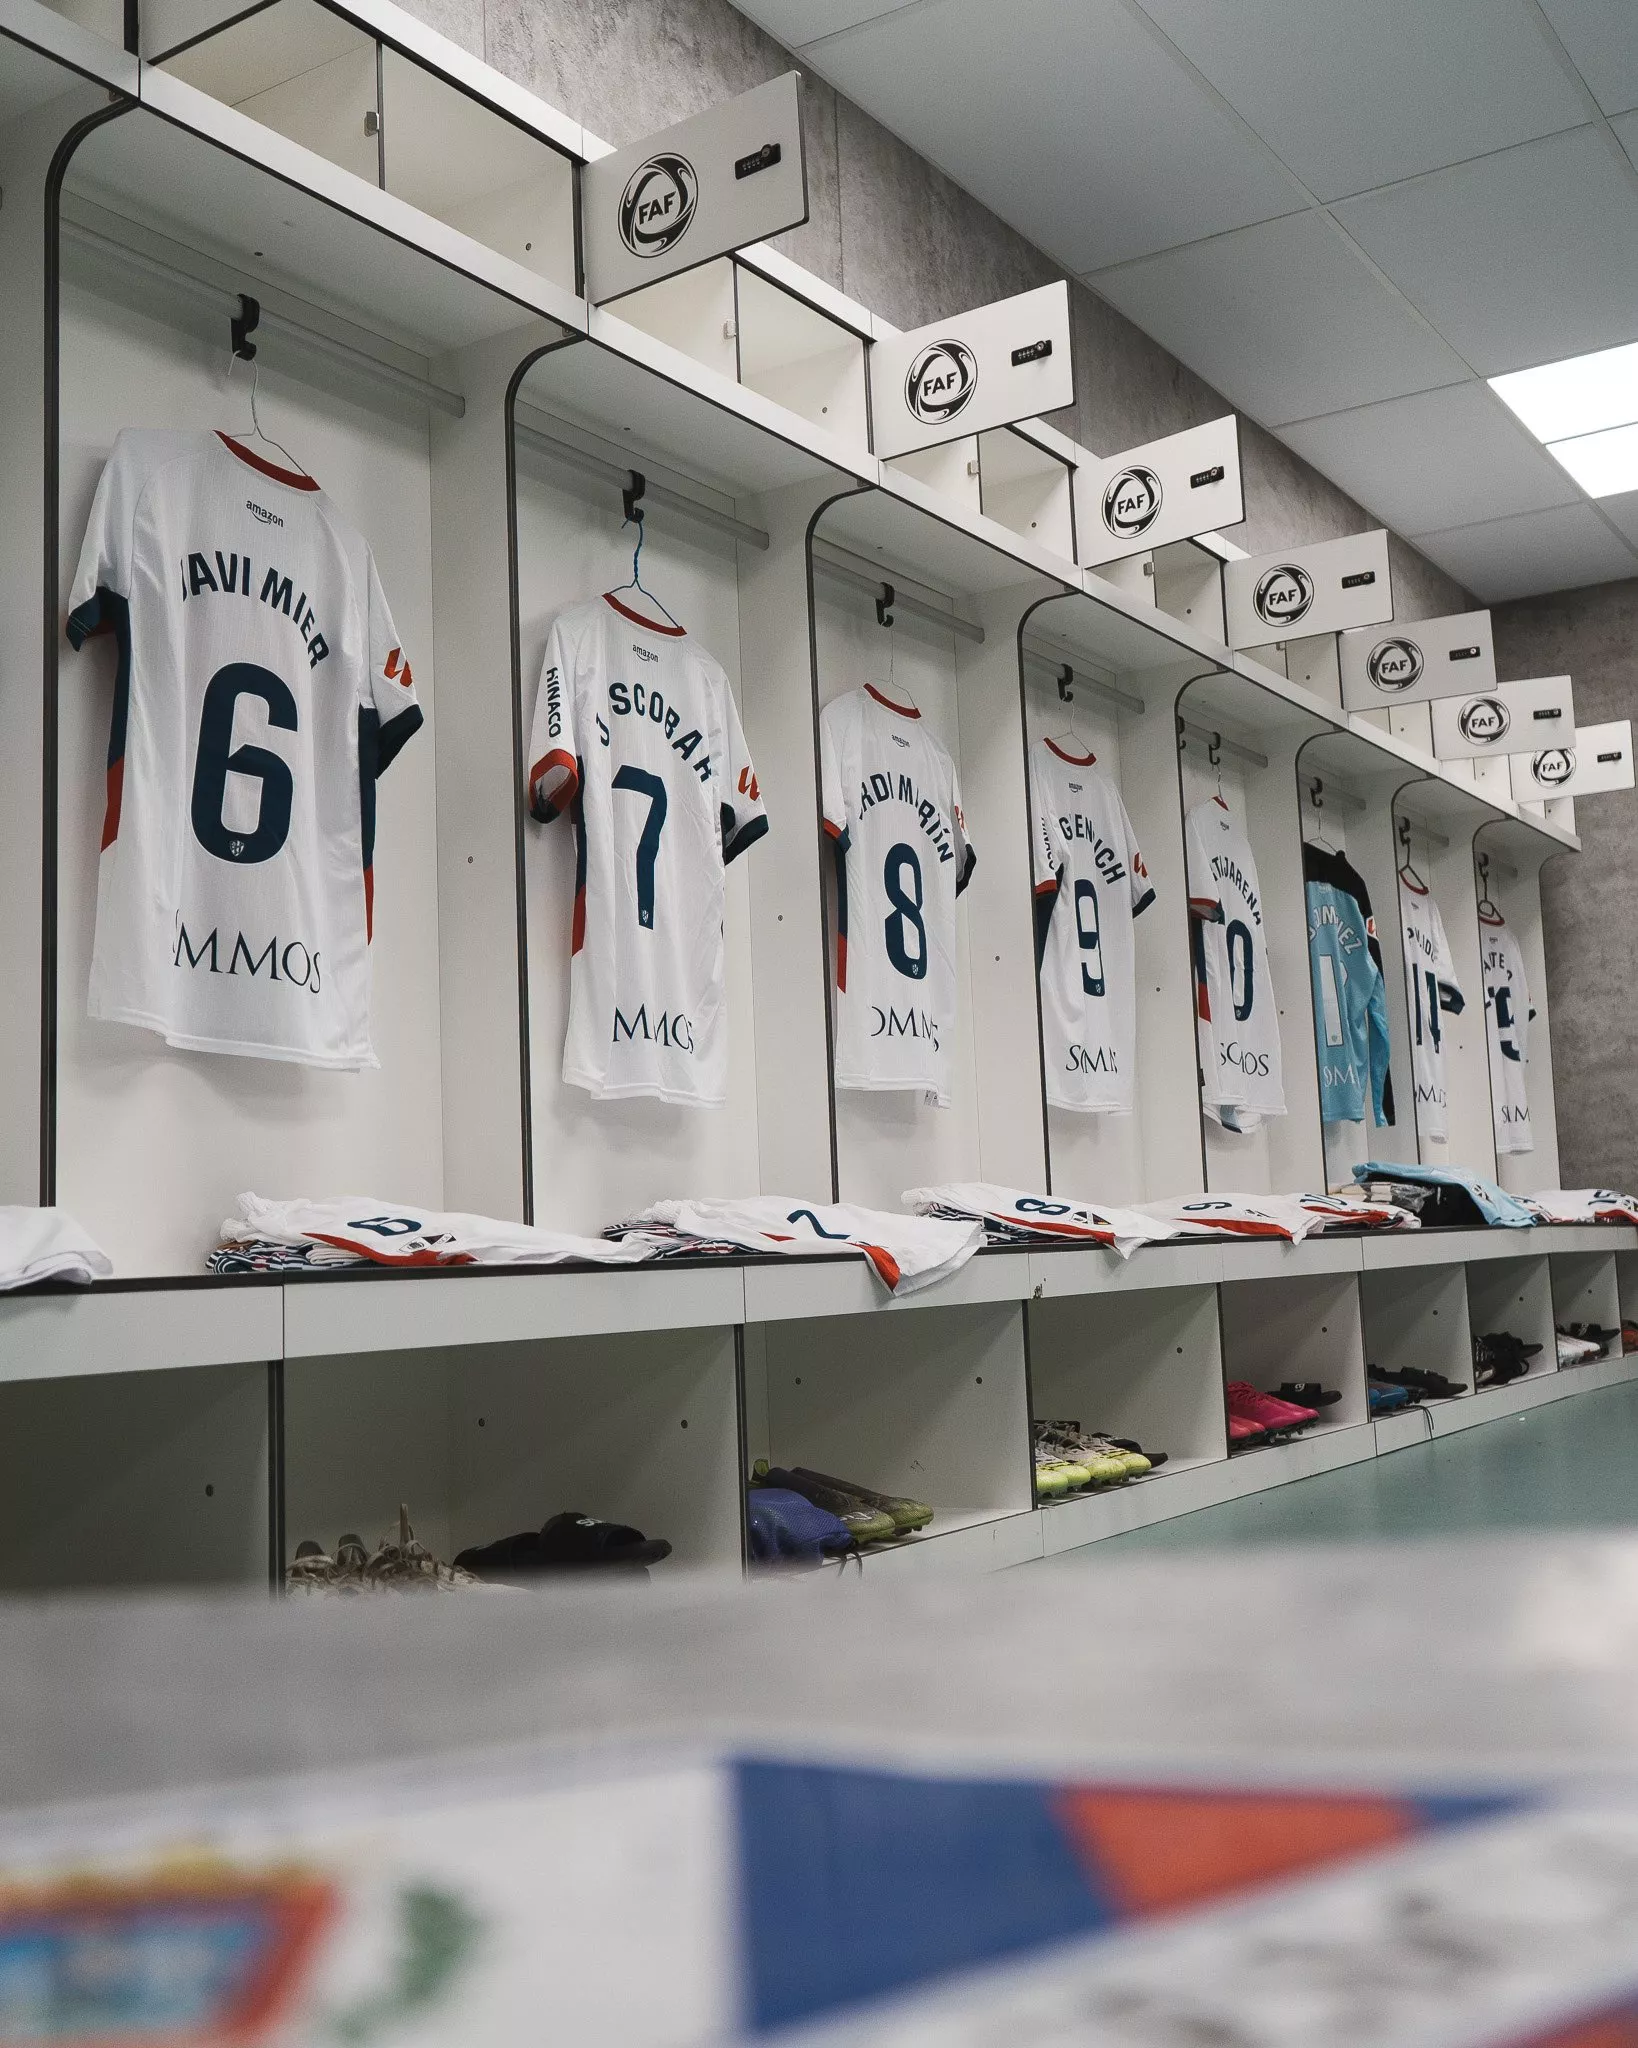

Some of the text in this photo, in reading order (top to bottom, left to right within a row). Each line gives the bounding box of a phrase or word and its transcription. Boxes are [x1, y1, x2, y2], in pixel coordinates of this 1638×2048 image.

[638, 190, 677, 225] FAF
[923, 371, 958, 397] FAF
[246, 500, 284, 527] amazon
[1117, 493, 1146, 515] FAF
[1269, 588, 1298, 606] FAF
[259, 566, 330, 670] MIER
[632, 644, 659, 663] amazon
[1381, 659, 1409, 673] FAF
[546, 667, 562, 738] HINACO
[1471, 716, 1497, 729] FAF
[191, 661, 299, 864] 6
[1542, 761, 1563, 772] FAF
[611, 764, 668, 930] 7
[884, 842, 927, 980] 8
[1074, 878, 1106, 997] 9
[172, 908, 321, 995] MMOS
[1015, 1198, 1071, 1216] 8
[347, 1217, 422, 1237] 6
[786, 1209, 851, 1240] 7
